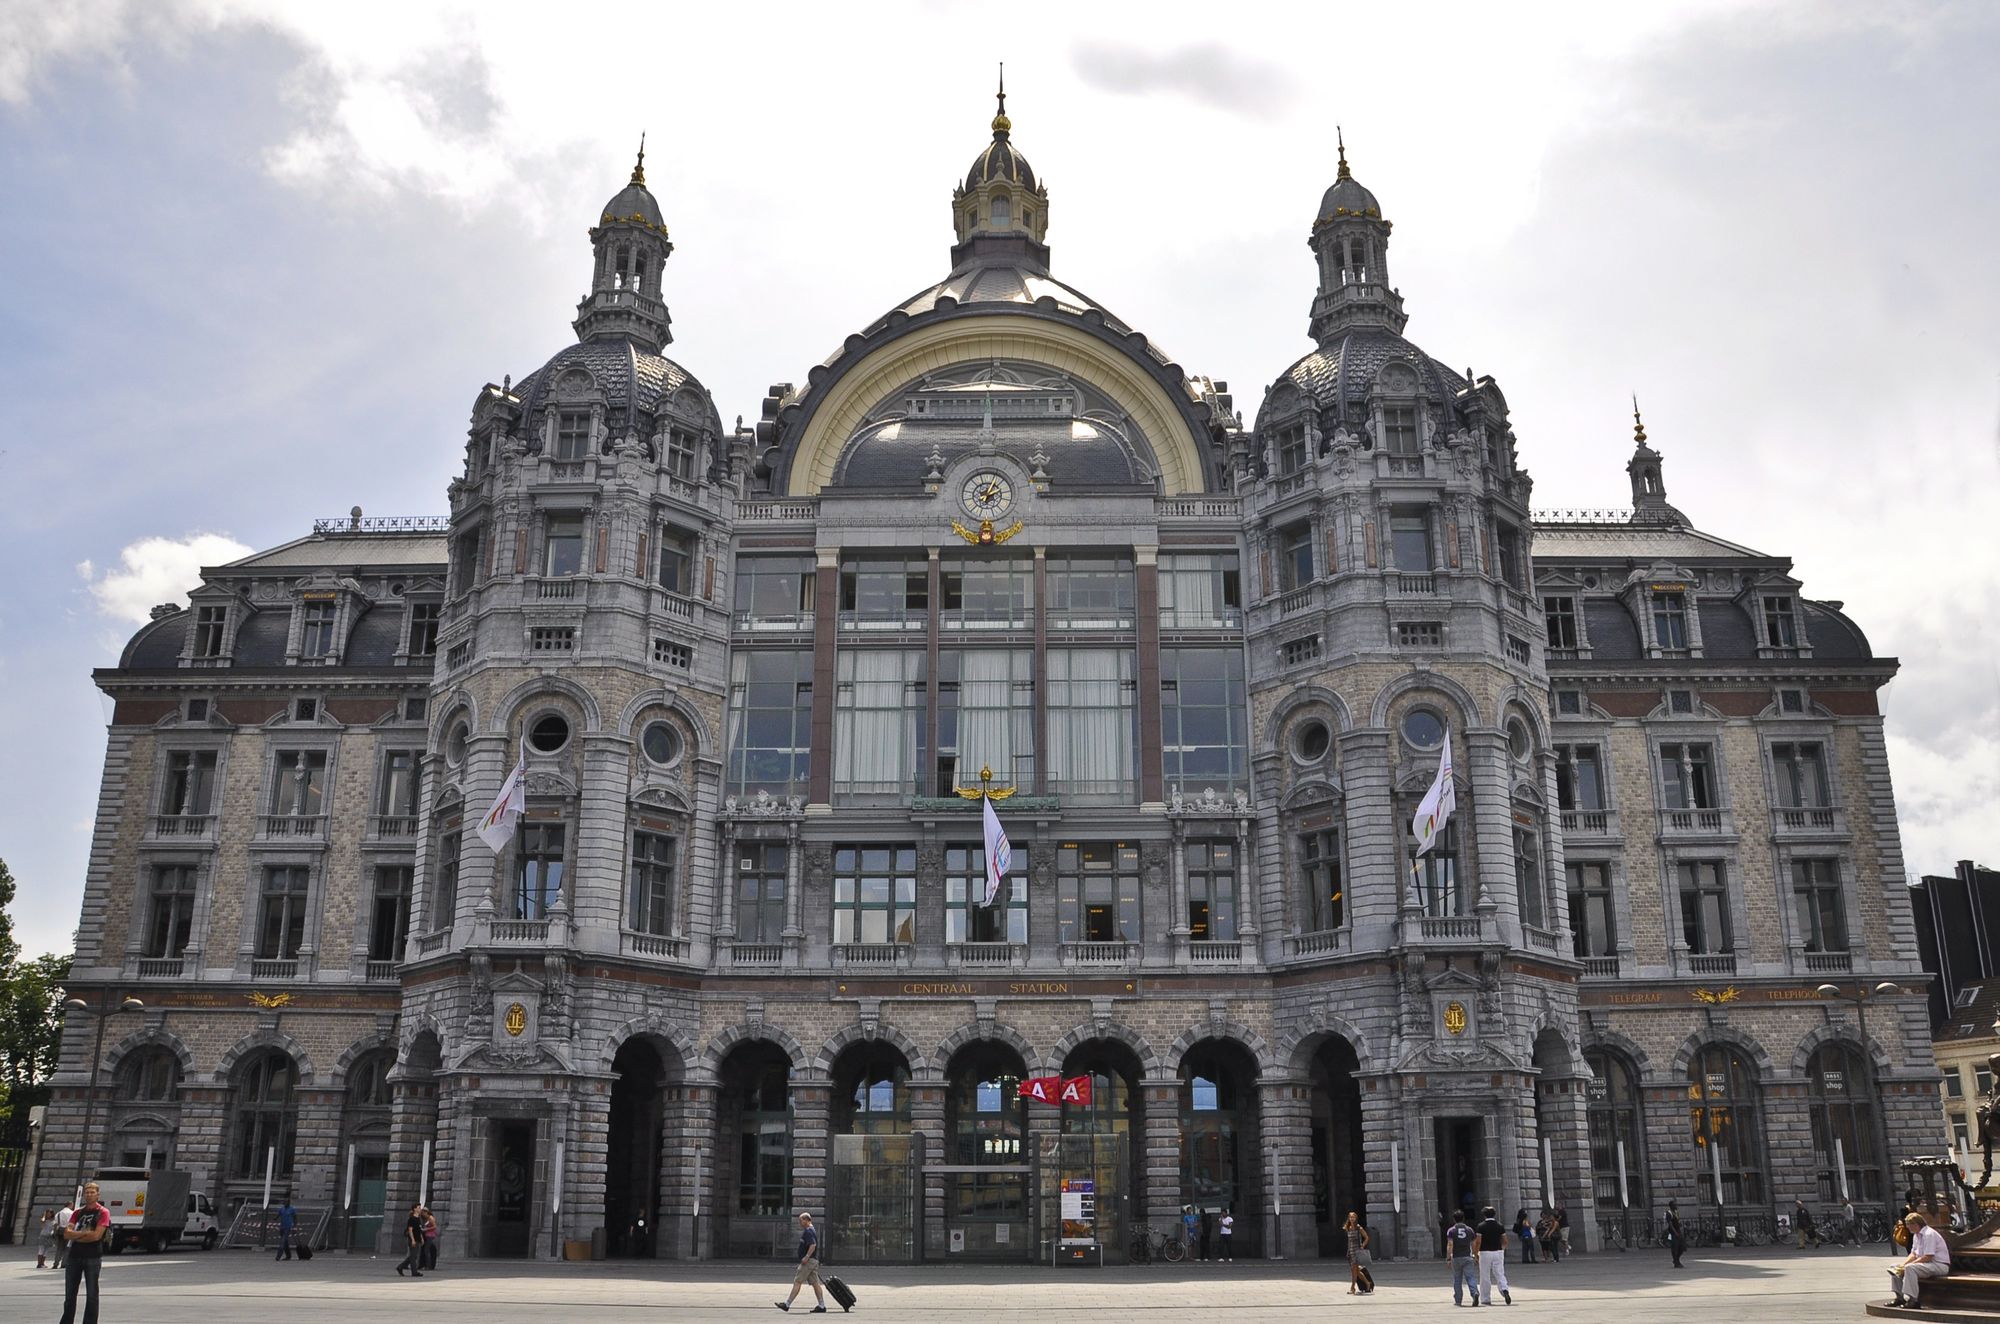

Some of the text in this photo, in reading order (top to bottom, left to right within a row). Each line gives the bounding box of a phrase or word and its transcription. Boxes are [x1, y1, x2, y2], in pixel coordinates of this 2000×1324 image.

[903, 983, 1068, 994] CENTRAAL STATION
[1609, 993, 1662, 1004] TELEGRAAF
[1768, 990, 1822, 999] TELEPHOON
[1061, 1082, 1080, 1100] A
[1708, 1083, 1725, 1092] shop
[1825, 1082, 1843, 1091] shop
[1589, 1087, 1607, 1096] shop
[1069, 1183, 1084, 1191] LIVE
[1457, 1228, 1467, 1239] 5
